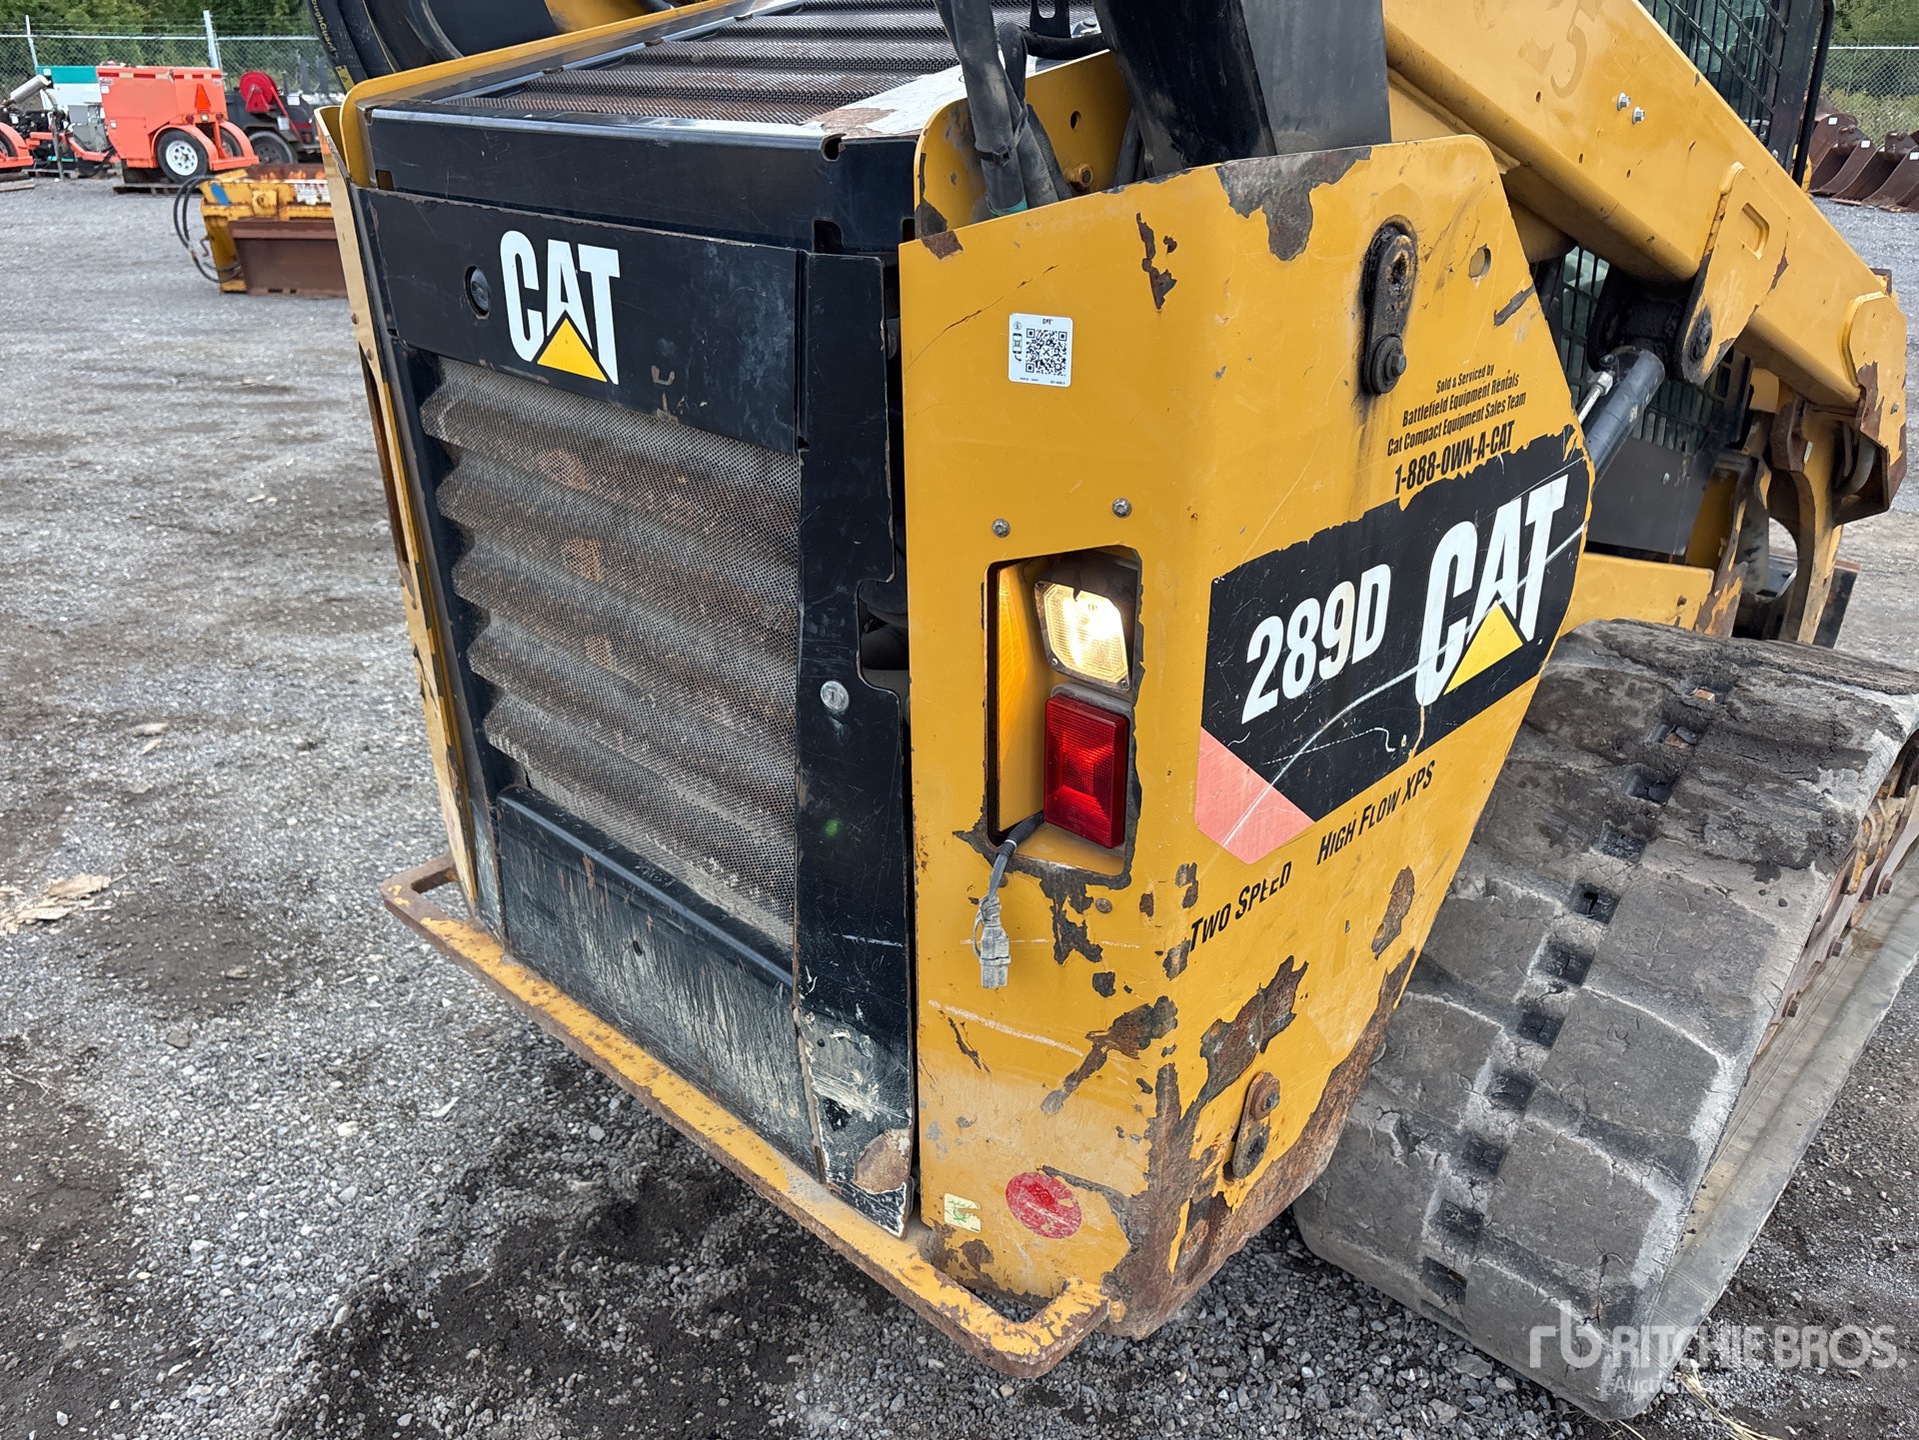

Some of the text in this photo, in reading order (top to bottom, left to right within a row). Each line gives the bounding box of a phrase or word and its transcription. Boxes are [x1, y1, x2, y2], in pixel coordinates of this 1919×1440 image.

[500, 230, 621, 385] CAT
[1402, 374, 1519, 427] Battlefield Equipment Rentals
[1436, 364, 1495, 394] Sold & Serviced by
[1387, 392, 1527, 456] Cat Compact Equipment Sales Team
[1394, 420, 1515, 494] 1-888-OWN-A-CAT
[1415, 474, 1569, 706] CAT
[1241, 564, 1391, 724] 289D
[1401, 760, 1436, 806] XPS
